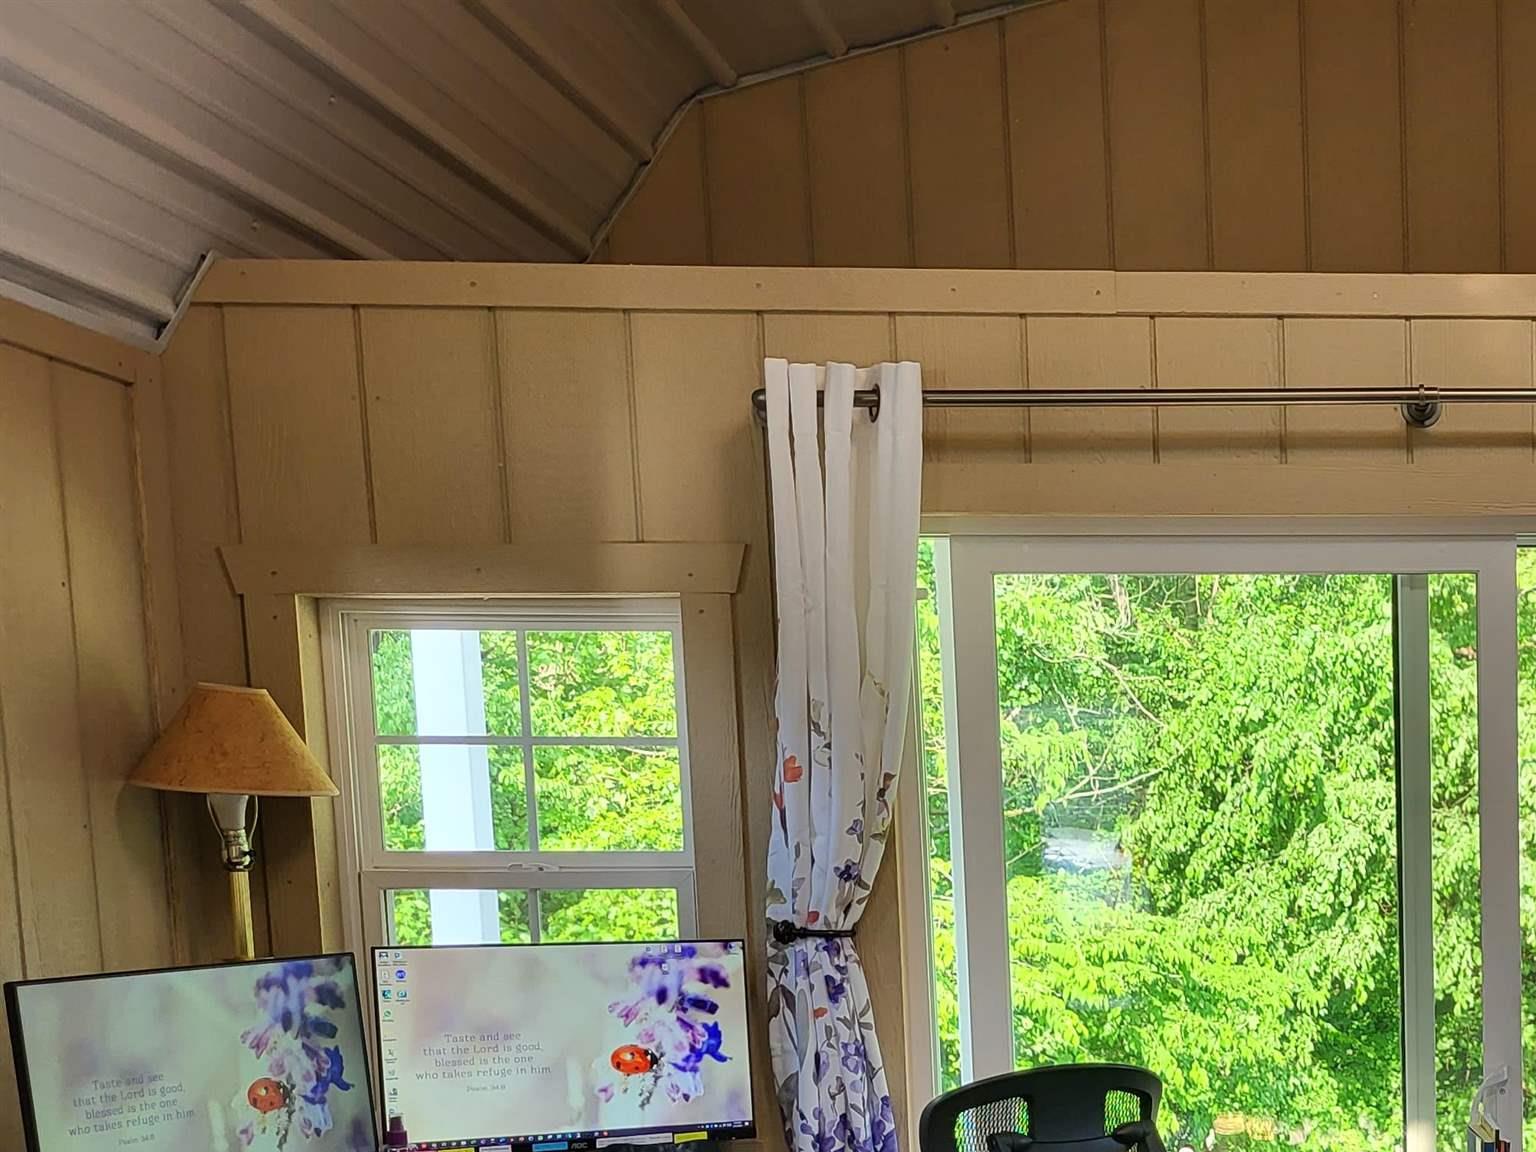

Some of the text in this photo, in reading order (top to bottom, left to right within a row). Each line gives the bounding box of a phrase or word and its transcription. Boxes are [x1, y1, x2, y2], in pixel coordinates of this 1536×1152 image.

[444, 1032, 521, 1043] Taste and see
[423, 1047, 447, 1056] that
[451, 1045, 470, 1055] the
[473, 1043, 499, 1054] Lord
[503, 1042, 512, 1052] is
[434, 1054, 534, 1068] blessed is the one
[415, 1070, 439, 1081] who
[442, 1068, 473, 1079] takes
[476, 1066, 513, 1078] refuge
[516, 1066, 527, 1075] in
[92, 1073, 164, 1091] Taste and see
[73, 1095, 96, 1108] that
[100, 1092, 117, 1103] the
[120, 1088, 145, 1100] Lord
[148, 1086, 157, 1096] is
[85, 1098, 178, 1120] blessed is the one
[68, 1125, 91, 1136] who
[94, 1120, 123, 1133] takes
[126, 1114, 160, 1128] refuge
[163, 1112, 173, 1121] in
